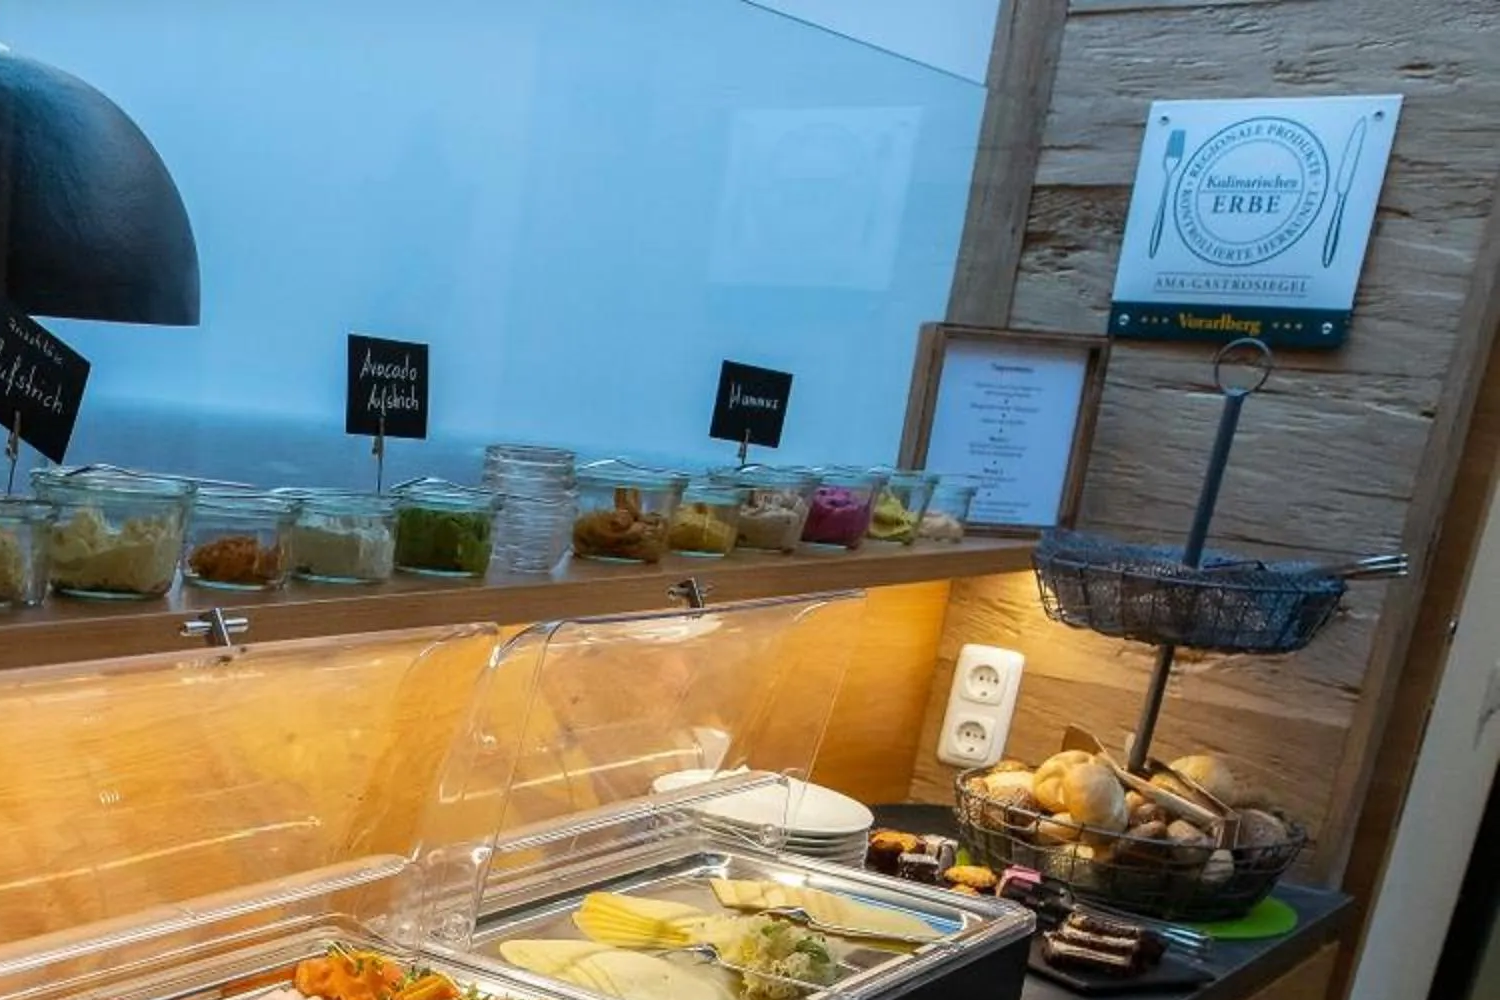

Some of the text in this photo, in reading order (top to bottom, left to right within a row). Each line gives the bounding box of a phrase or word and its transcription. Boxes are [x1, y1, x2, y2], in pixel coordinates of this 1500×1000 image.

[1189, 122, 1322, 179] REGIONALE PRODUKTE
[1206, 173, 1298, 190] Kulinarisches
[1210, 194, 1282, 215] ERBE
[1155, 277, 1309, 294] AMA-GASTROSIEGEL
[1178, 312, 1262, 335] Vorarlberg
[360, 347, 418, 381] Avocado
